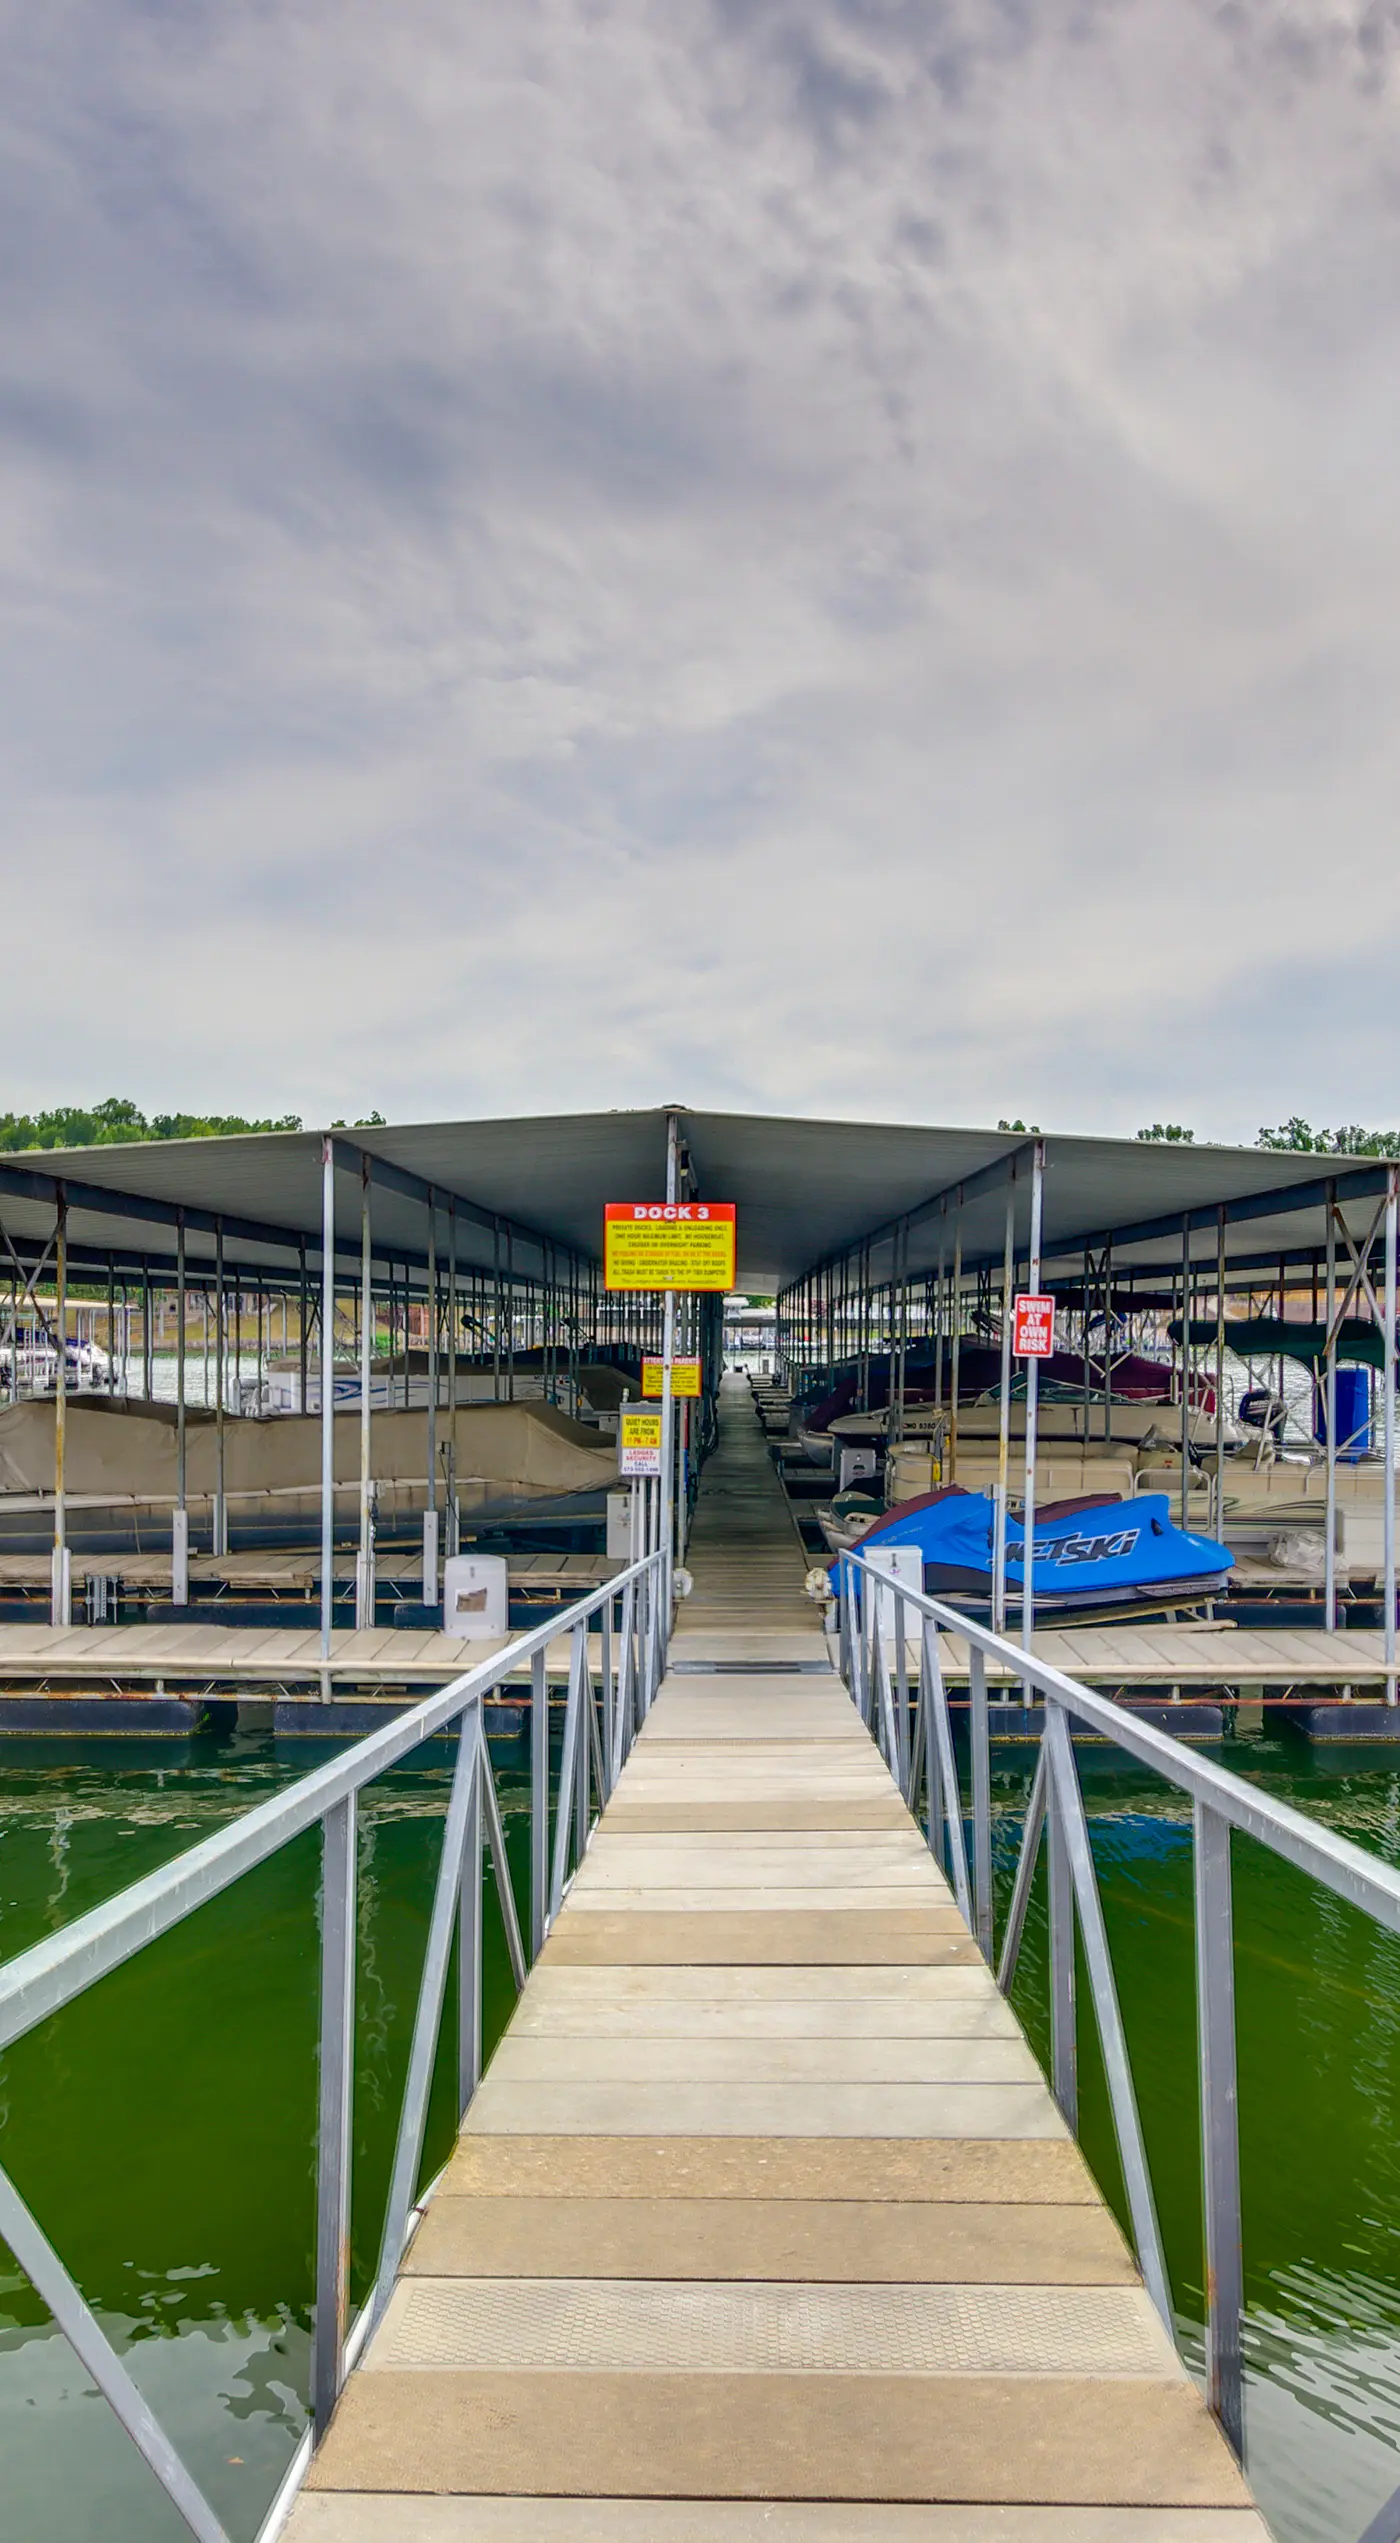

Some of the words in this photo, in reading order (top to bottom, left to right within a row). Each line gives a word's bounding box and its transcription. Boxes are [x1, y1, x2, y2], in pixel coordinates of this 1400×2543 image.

[634, 1206, 692, 1220] DOCK
[697, 1206, 710, 1220] 3
[1019, 1300, 1051, 1314] SWIM
[1026, 1313, 1043, 1326] AT
[1020, 1325, 1048, 1339] OWN
[1019, 1338, 1048, 1352] RISK
[626, 1418, 641, 1426] QUIET
[642, 1418, 659, 1426] HOURS
[629, 1427, 639, 1435] ARE
[640, 1427, 655, 1435] FROM
